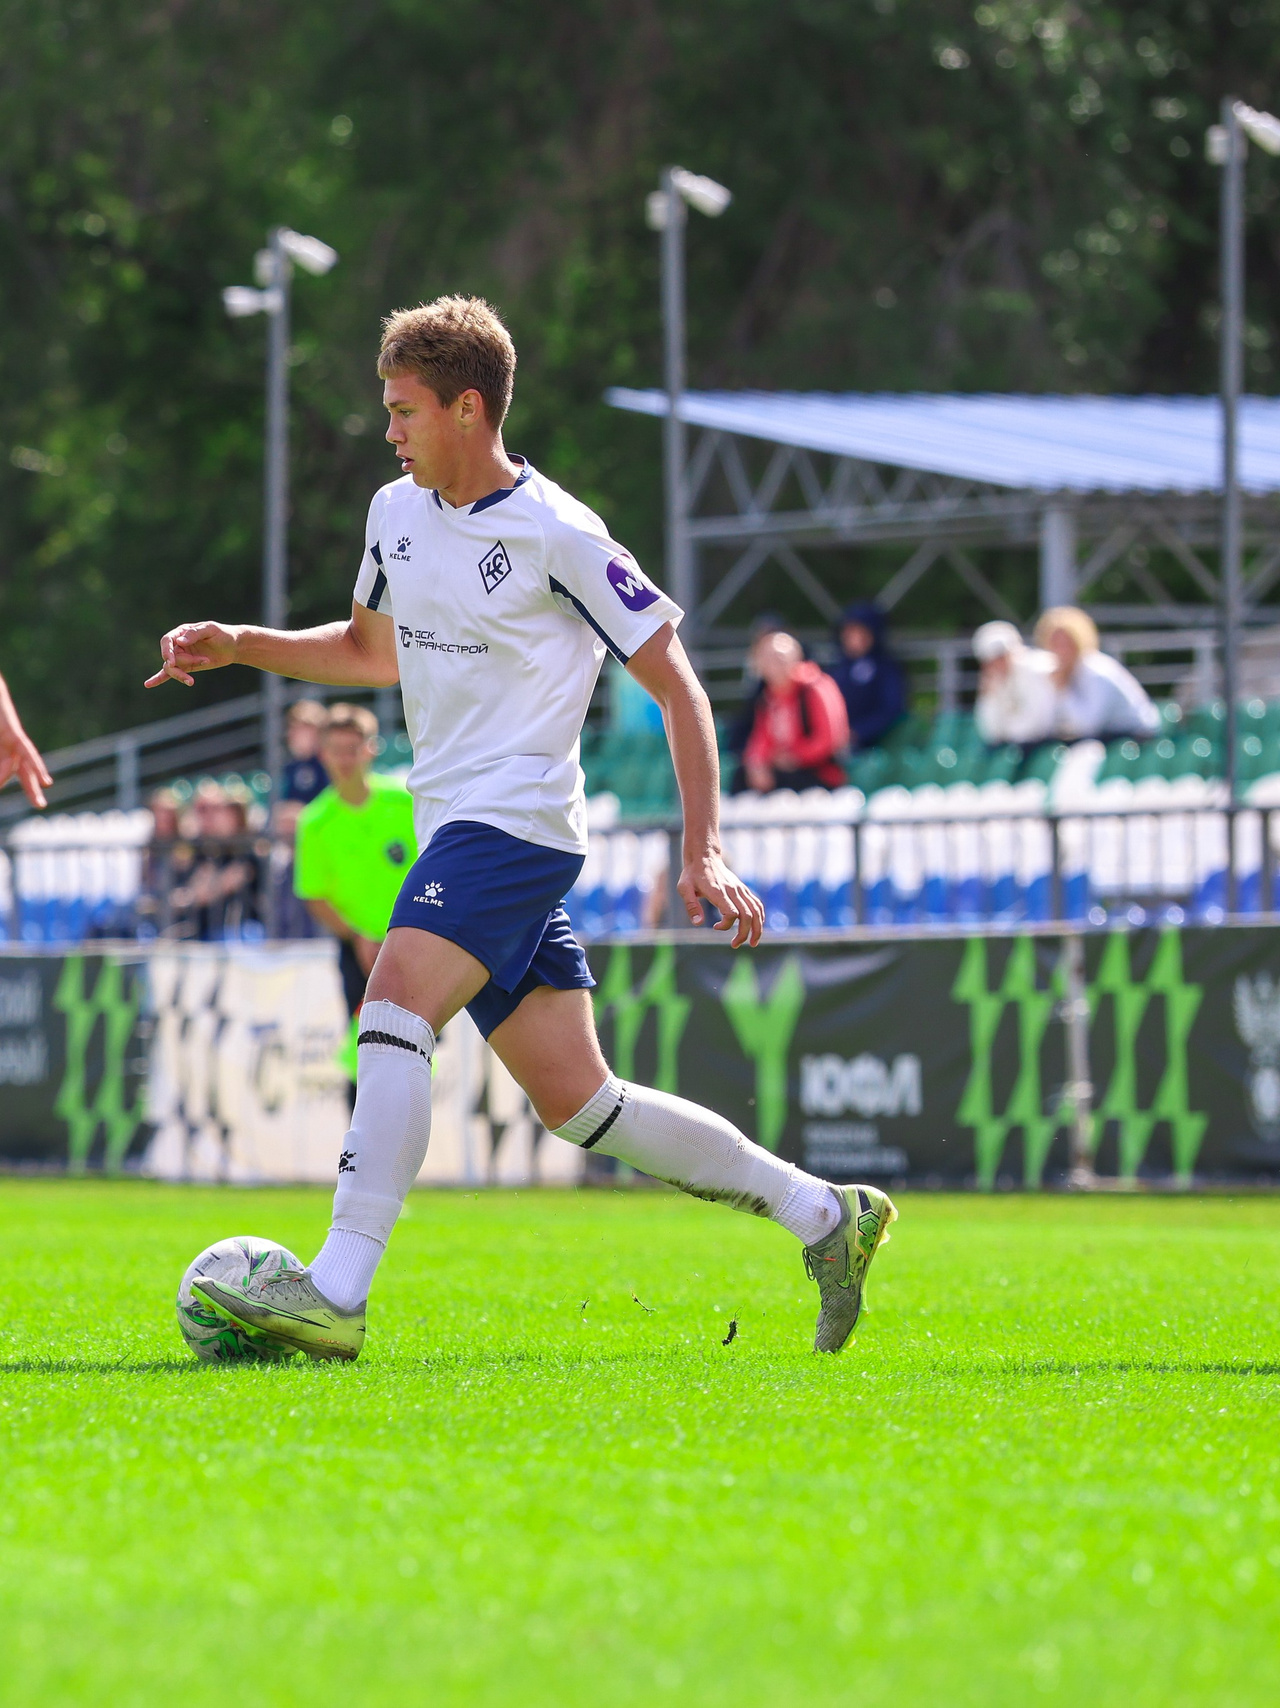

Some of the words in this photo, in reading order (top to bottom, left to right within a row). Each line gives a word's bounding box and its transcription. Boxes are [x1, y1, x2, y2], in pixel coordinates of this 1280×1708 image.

[389, 552, 412, 562] KELME
[415, 639, 489, 654] ТРАНССТРОЙ
[412, 895, 444, 907] KELME
